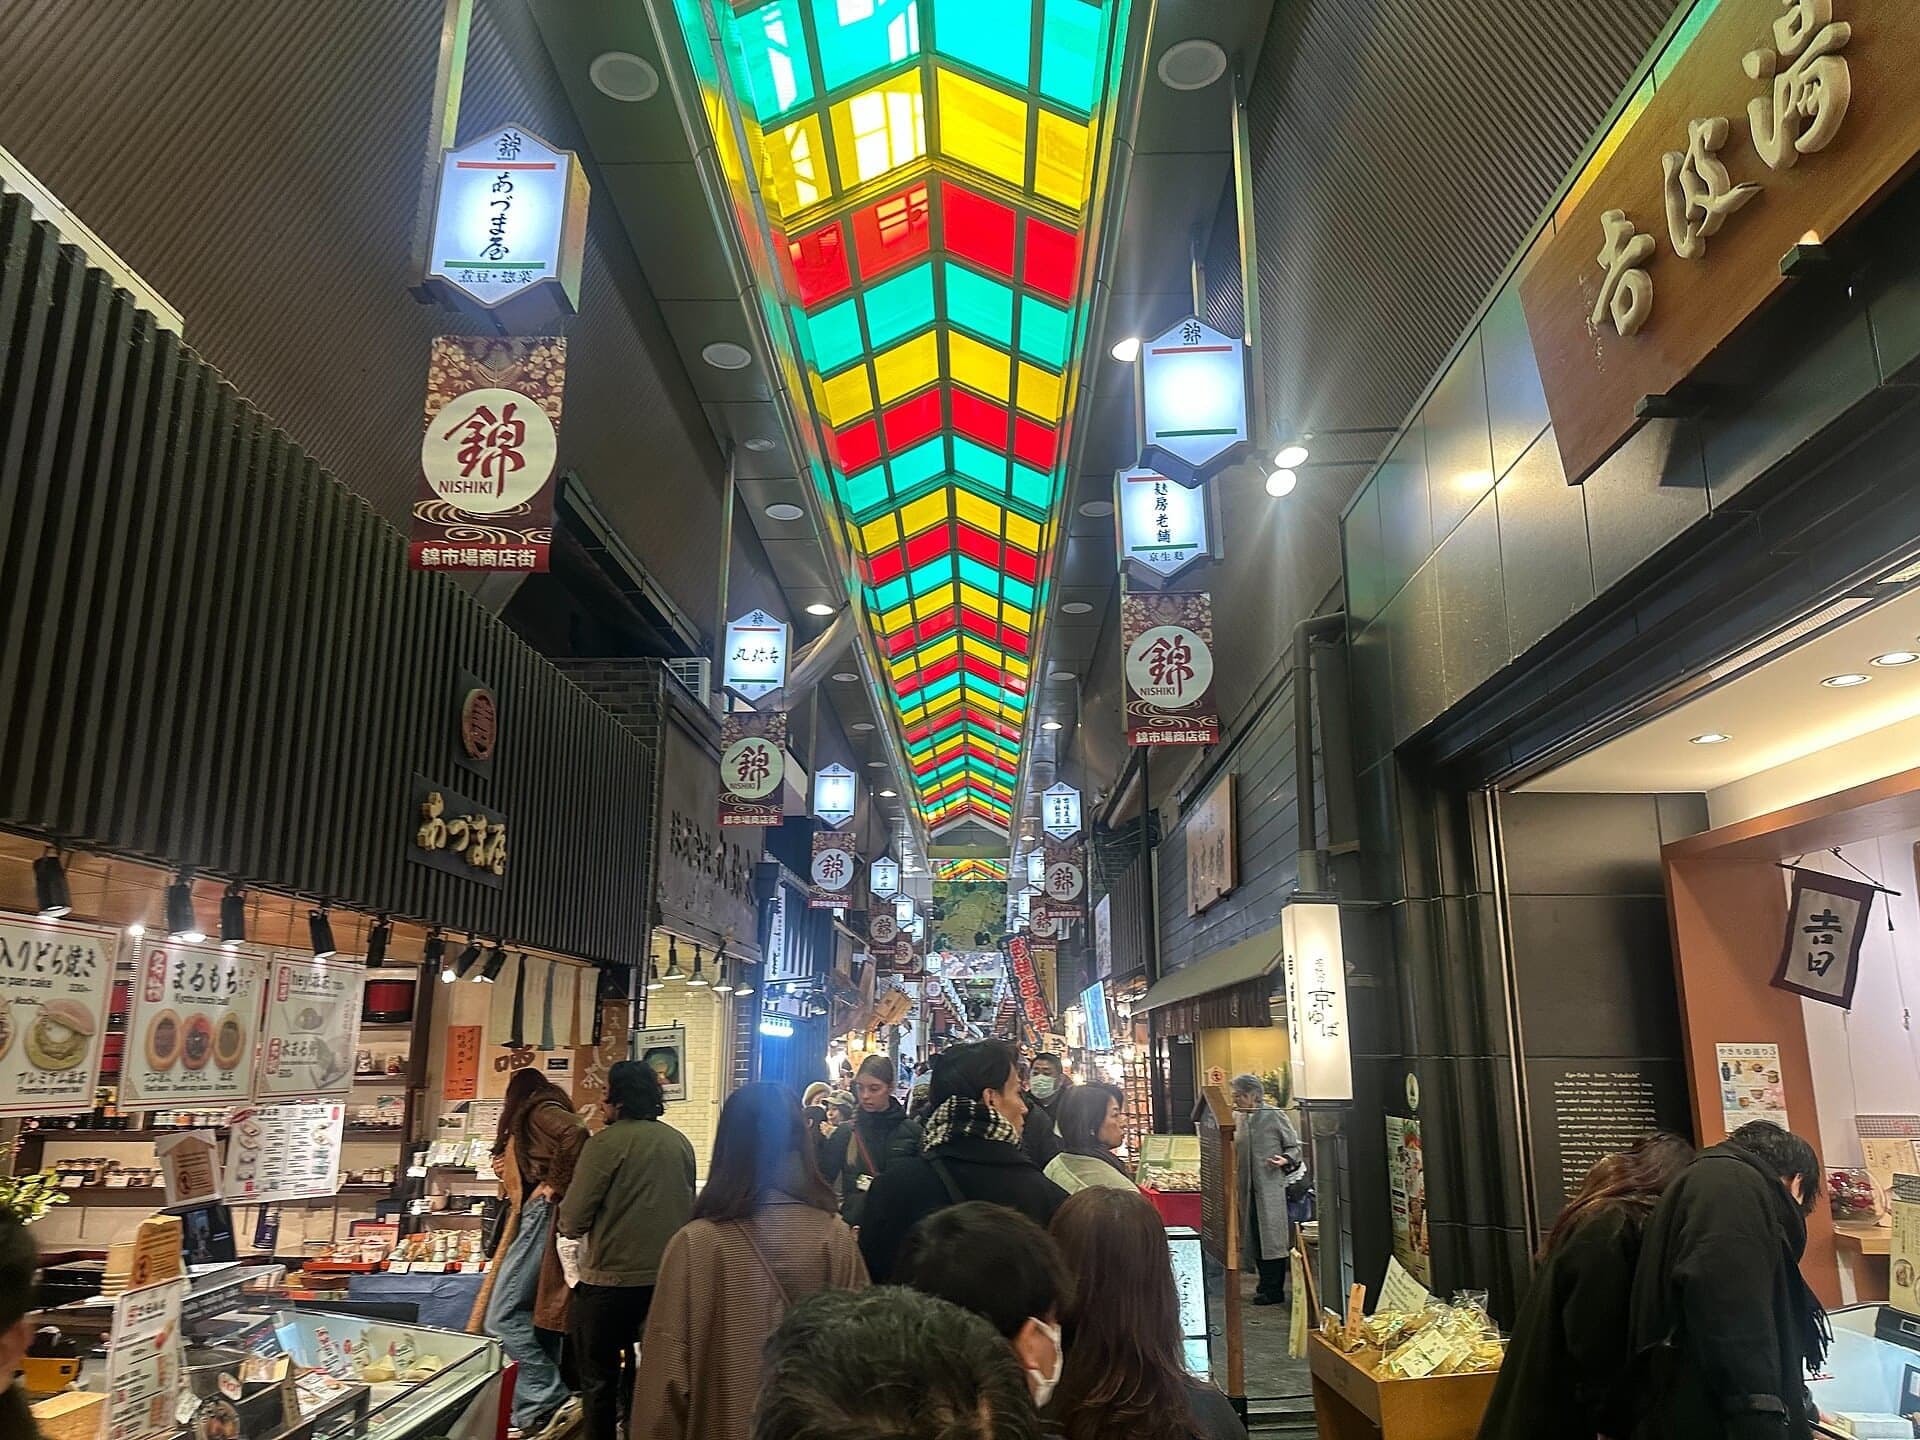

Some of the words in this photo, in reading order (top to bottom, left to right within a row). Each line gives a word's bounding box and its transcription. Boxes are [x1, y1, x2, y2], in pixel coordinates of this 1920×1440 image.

[480, 171, 515, 261] あづま屋
[443, 401, 526, 498] 錦
[438, 480, 493, 495] NISHIKI
[421, 546, 537, 569] 錦市場商店街
[1139, 634, 1195, 698] 錦
[1140, 687, 1176, 696] NISHIKI
[1136, 731, 1210, 743] 錦市場商店街
[730, 744, 770, 791] 錦
[817, 853, 844, 885] 錦
[1050, 867, 1074, 896] 錦
[173, 960, 238, 994] まるもち
